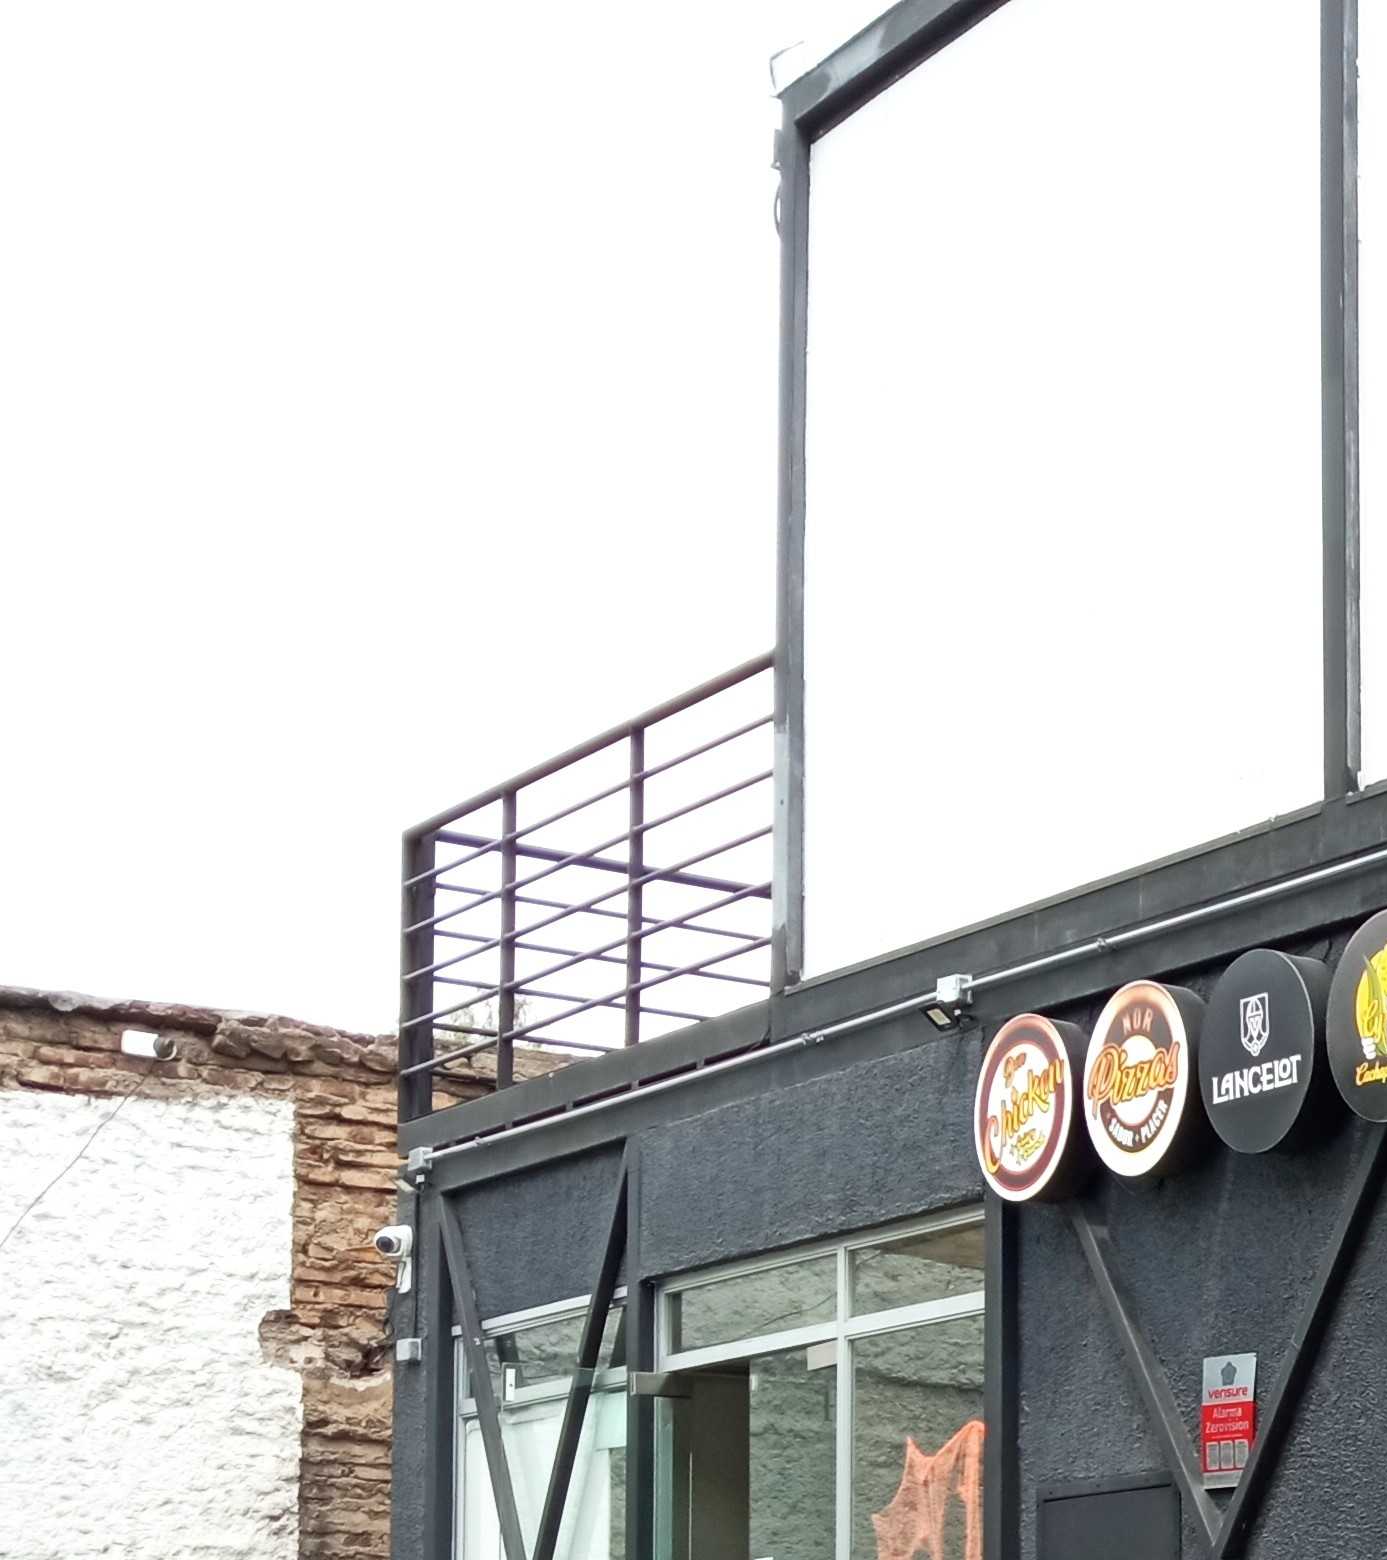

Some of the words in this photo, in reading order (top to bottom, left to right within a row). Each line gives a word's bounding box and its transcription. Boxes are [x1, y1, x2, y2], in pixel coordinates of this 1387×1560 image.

[983, 1057, 1065, 1174] Chicken
[1088, 1042, 1180, 1120] Pizzas
[1211, 1053, 1302, 1105] LANCELOT
